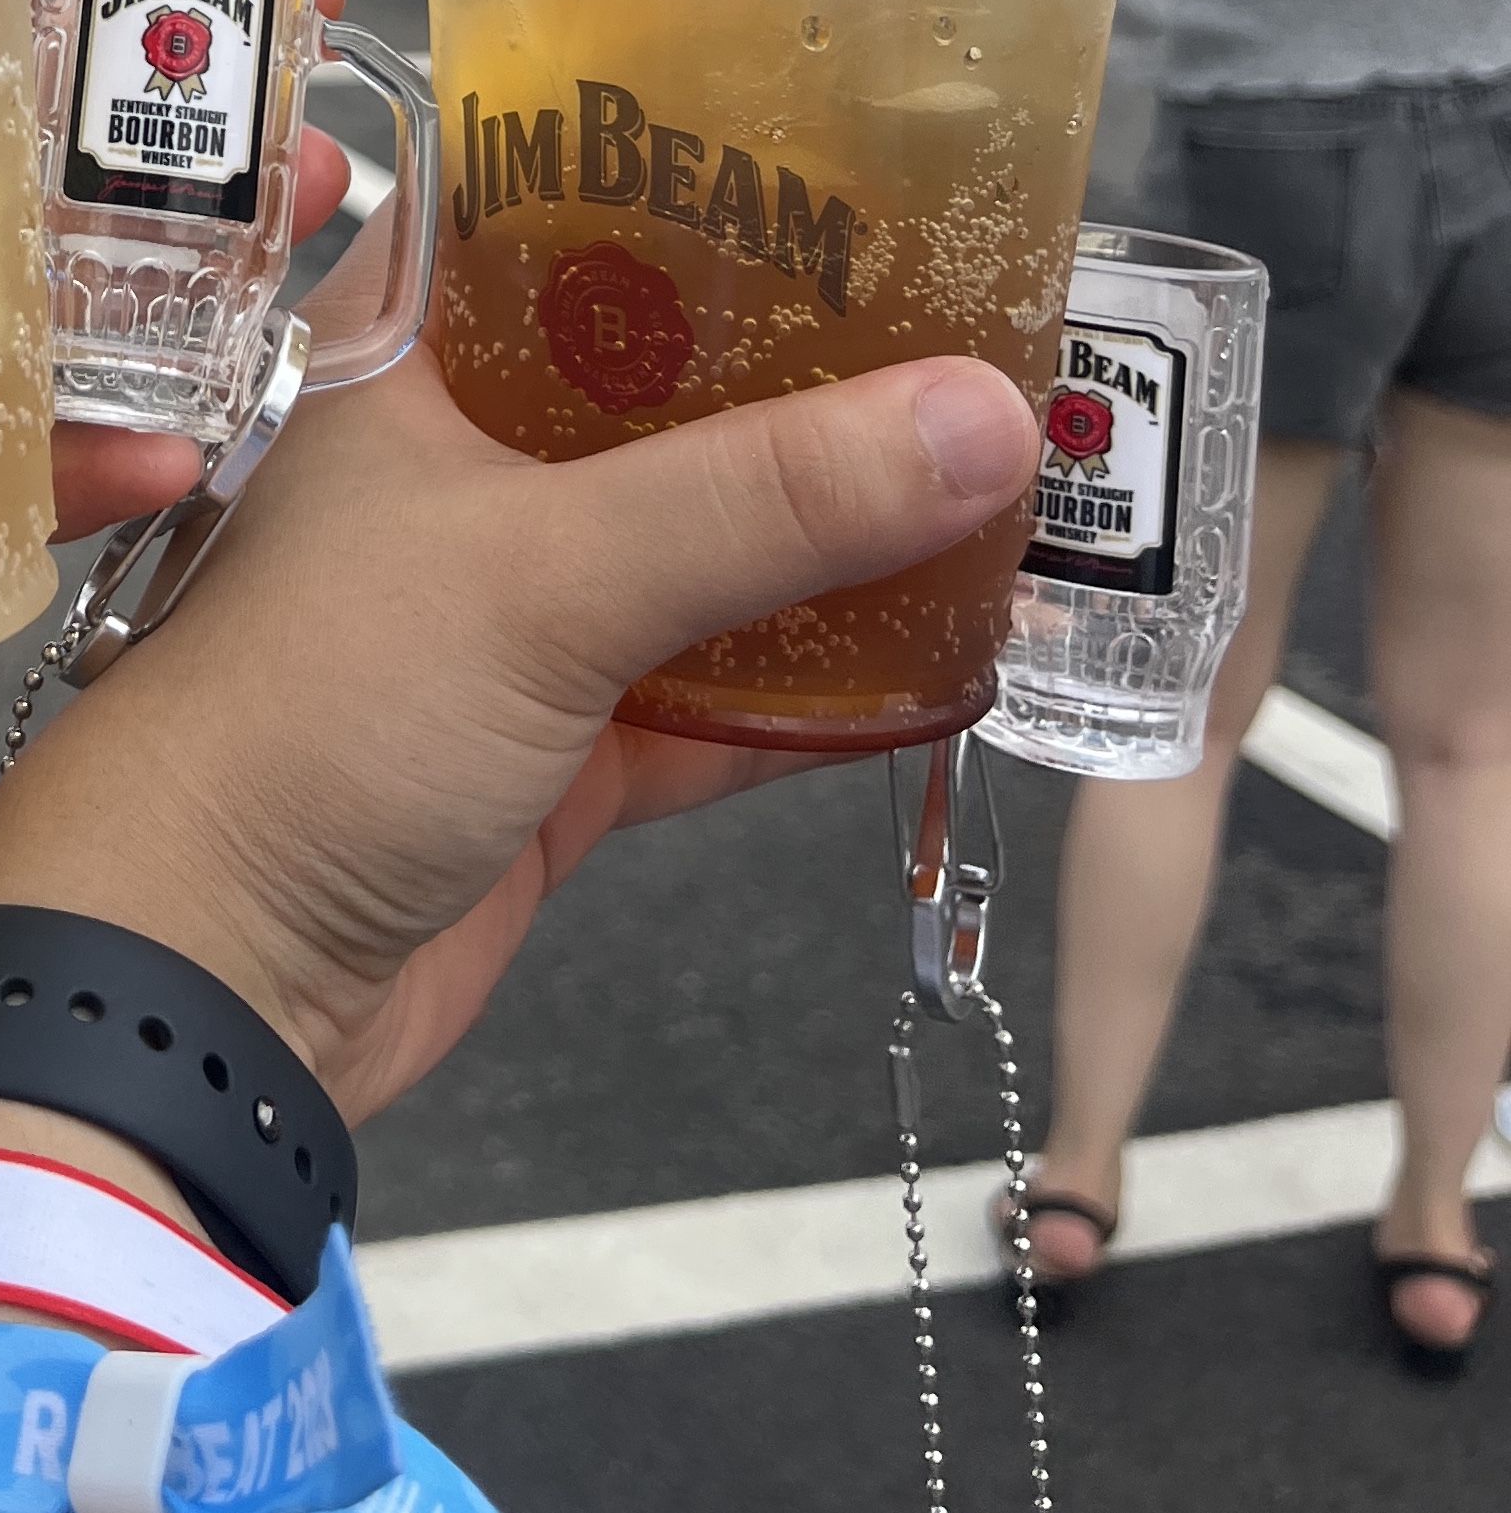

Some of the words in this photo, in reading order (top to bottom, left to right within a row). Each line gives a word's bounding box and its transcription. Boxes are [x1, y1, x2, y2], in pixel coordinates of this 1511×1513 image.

[111, 98, 172, 118] KENTUCKY
[175, 105, 228, 126] STRAIGHT
[108, 114, 227, 158] BOURBON
[141, 150, 194, 170] WHISKEY
[452, 91, 565, 241] JIM
[576, 79, 856, 318] BEAM
[1069, 339, 1160, 416] BEAM
[1077, 482, 1134, 503] STRAIGHT
[1033, 489, 1133, 534] OURBON
[1045, 522, 1097, 544] WHISKEY
